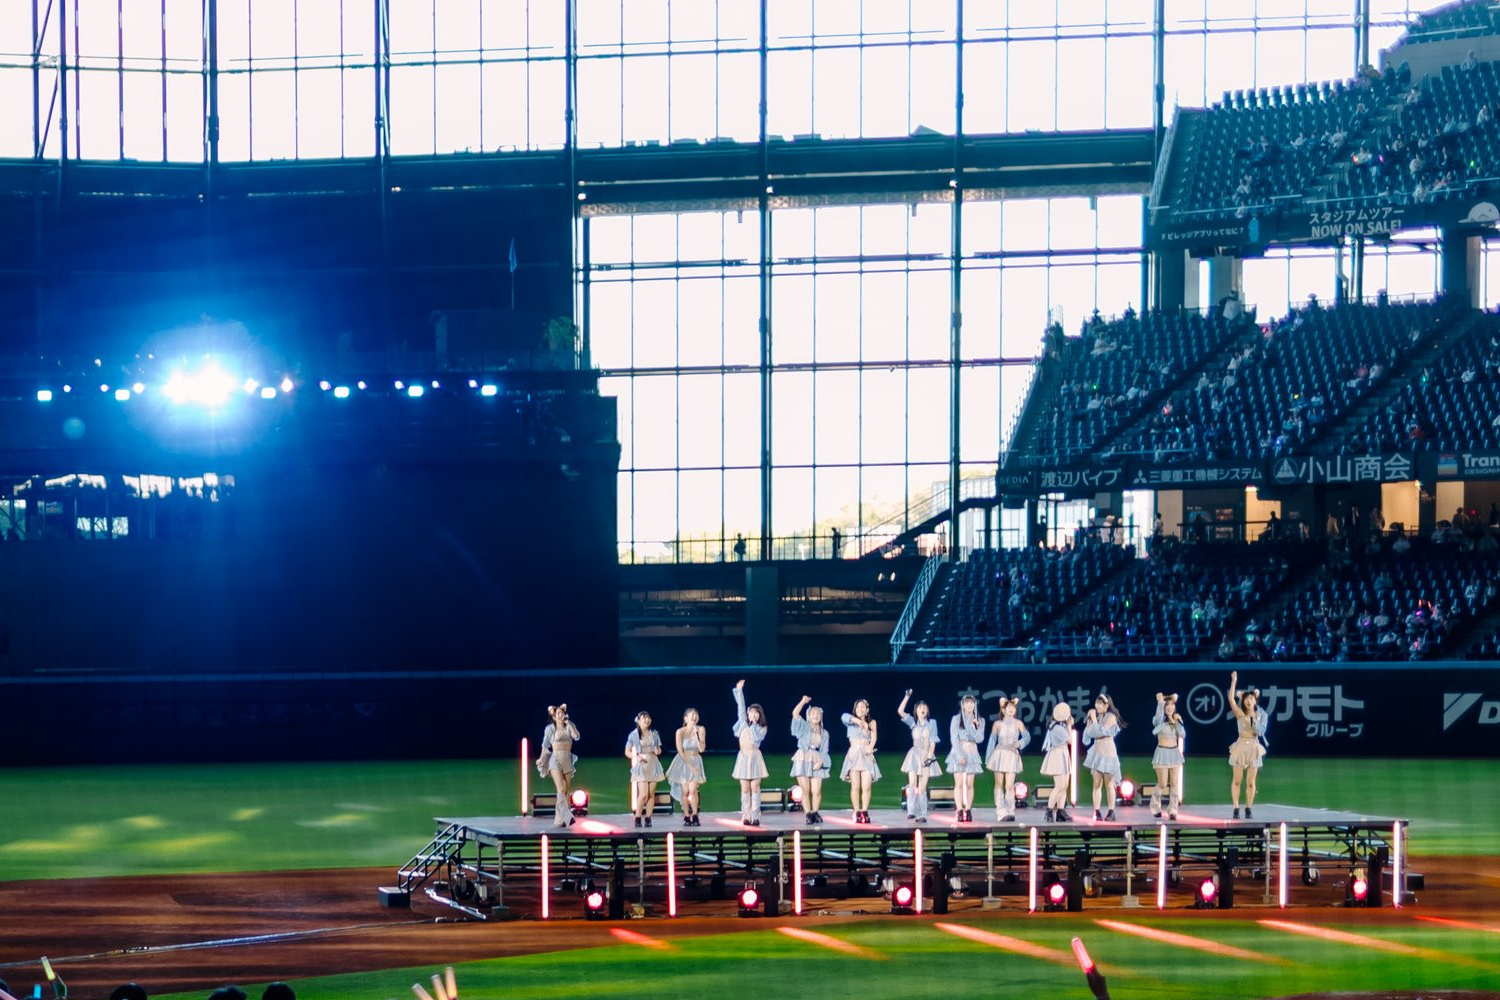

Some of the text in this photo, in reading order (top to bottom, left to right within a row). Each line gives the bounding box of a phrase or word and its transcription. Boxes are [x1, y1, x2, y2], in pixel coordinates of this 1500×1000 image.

[1309, 206, 1405, 225] スタジアムツアー
[1311, 223, 1342, 238] NOW
[1344, 222, 1364, 235] ON
[1298, 453, 1411, 484] 小山商会
[1306, 722, 1364, 738] グループ
